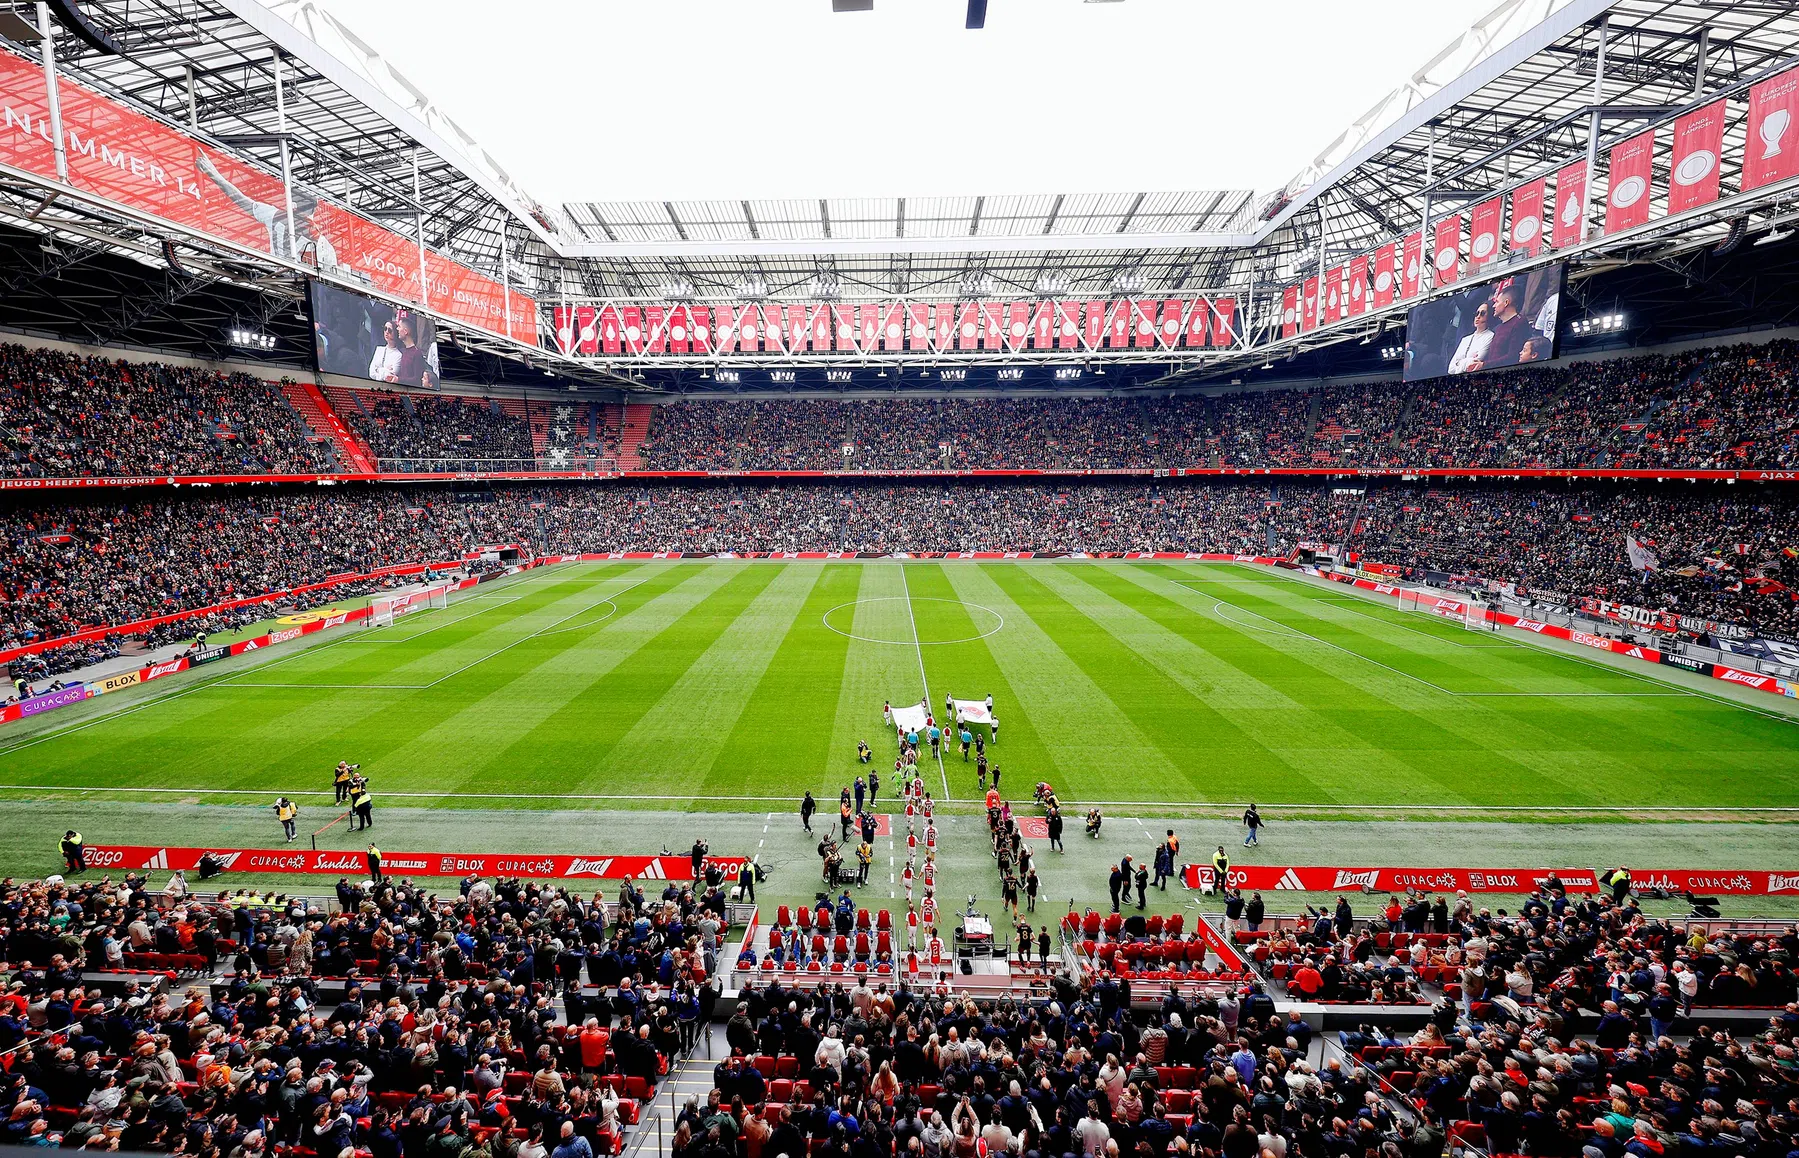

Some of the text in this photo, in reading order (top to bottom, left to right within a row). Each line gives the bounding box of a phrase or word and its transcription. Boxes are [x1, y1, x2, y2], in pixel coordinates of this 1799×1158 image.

[1760, 80, 1797, 99] EUROPESE
[1681, 120, 1714, 137] KAMPIOEN
[1687, 117, 1709, 129] LANDS
[1762, 171, 1777, 179] 1974
[362, 252, 450, 297] VOOR ATIJD
[452, 290, 489, 312] JOHAN
[1759, 471, 1796, 480] AJAX
[1, 480, 41, 489] JEUGD
[46, 479, 82, 487] HEEFT
[104, 477, 156, 486] TOEKOMST
[1527, 587, 1568, 600] AMSTERDAM
[1599, 600, 1660, 626] F-SIDE
[195, 649, 224, 662] UNIBET
[1668, 654, 1704, 670] UNIBET
[105, 674, 137, 690] BLOX
[1728, 671, 1759, 684] Bud
[312, 852, 363, 870] Sandals
[456, 859, 485, 871] BLOX
[571, 858, 605, 873] Bud
[1338, 870, 1373, 884] Bud
[1485, 875, 1519, 887] BLOX
[1629, 875, 1680, 889] andals
[1007, 882, 1016, 891] 16
[1022, 930, 1029, 940] 8
[932, 945, 939, 955] 2
